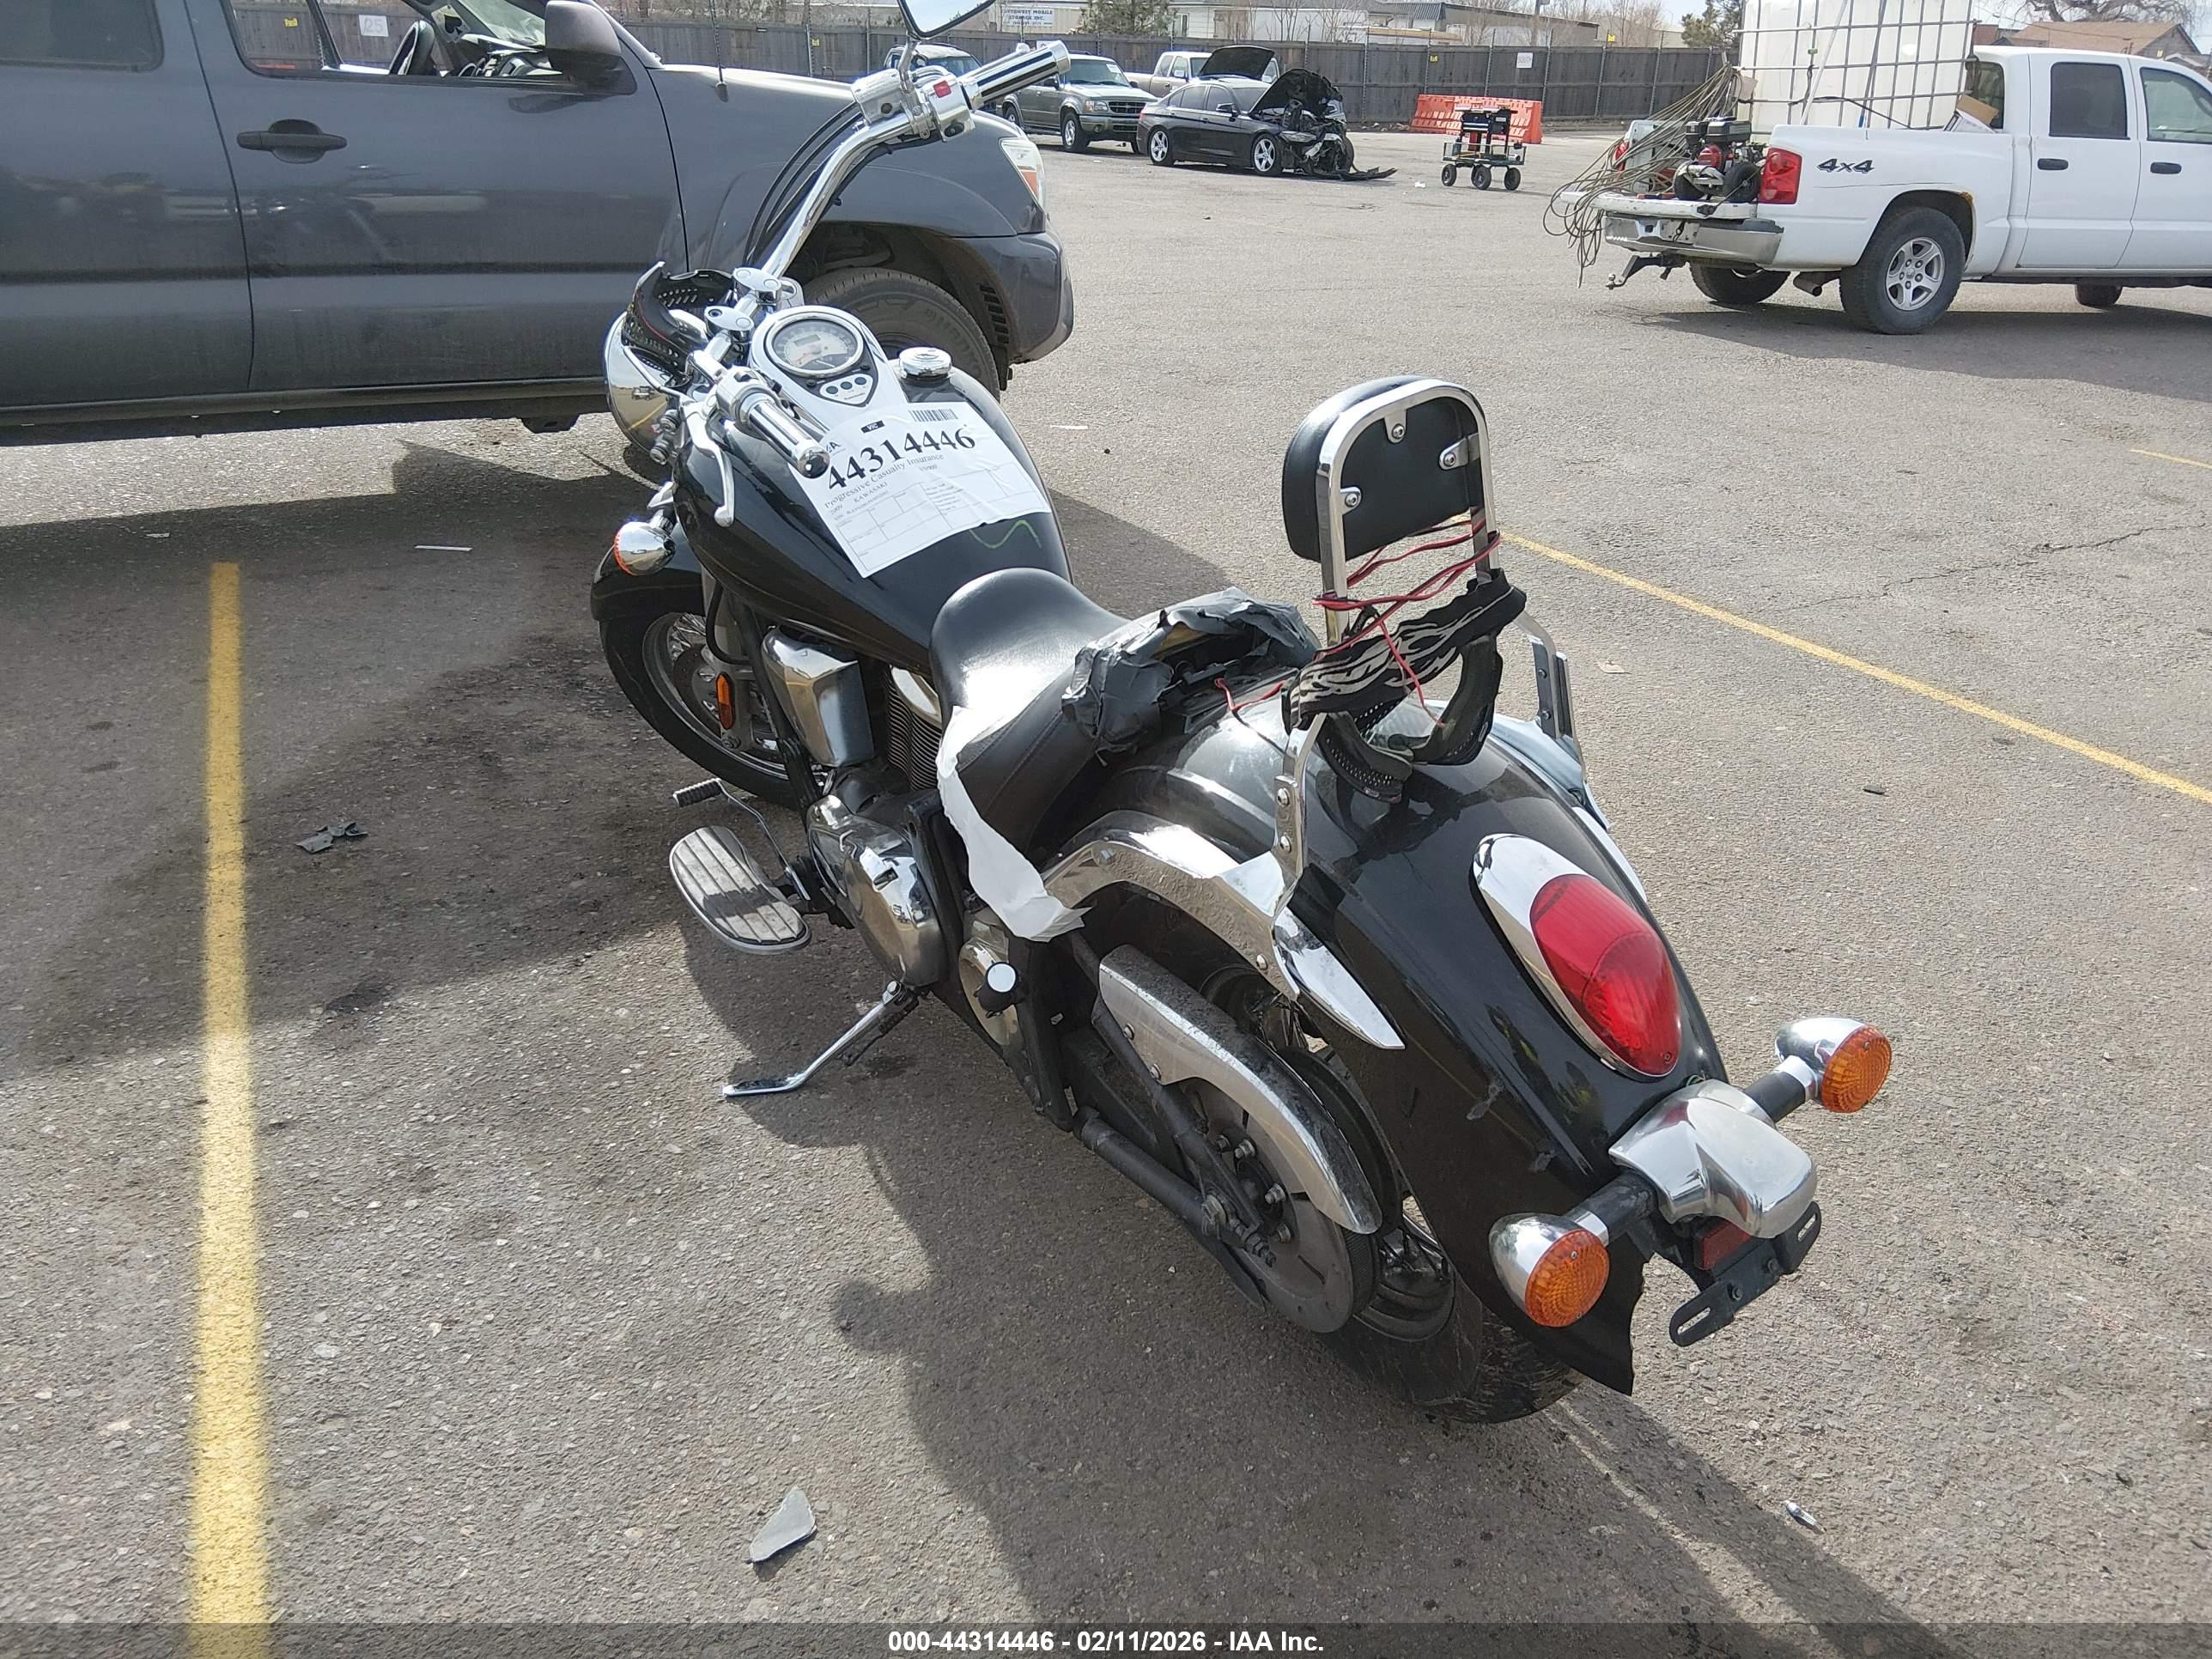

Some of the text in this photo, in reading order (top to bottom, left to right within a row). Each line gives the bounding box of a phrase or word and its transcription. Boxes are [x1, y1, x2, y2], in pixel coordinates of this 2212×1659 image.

[1817, 158, 1875, 173] 4x4
[829, 427, 975, 489] 44314446
[824, 481, 870, 508] Progressive
[871, 461, 905, 483] Casualty
[907, 454, 944, 465] Insurance
[854, 481, 888, 502] KAWASAKI
